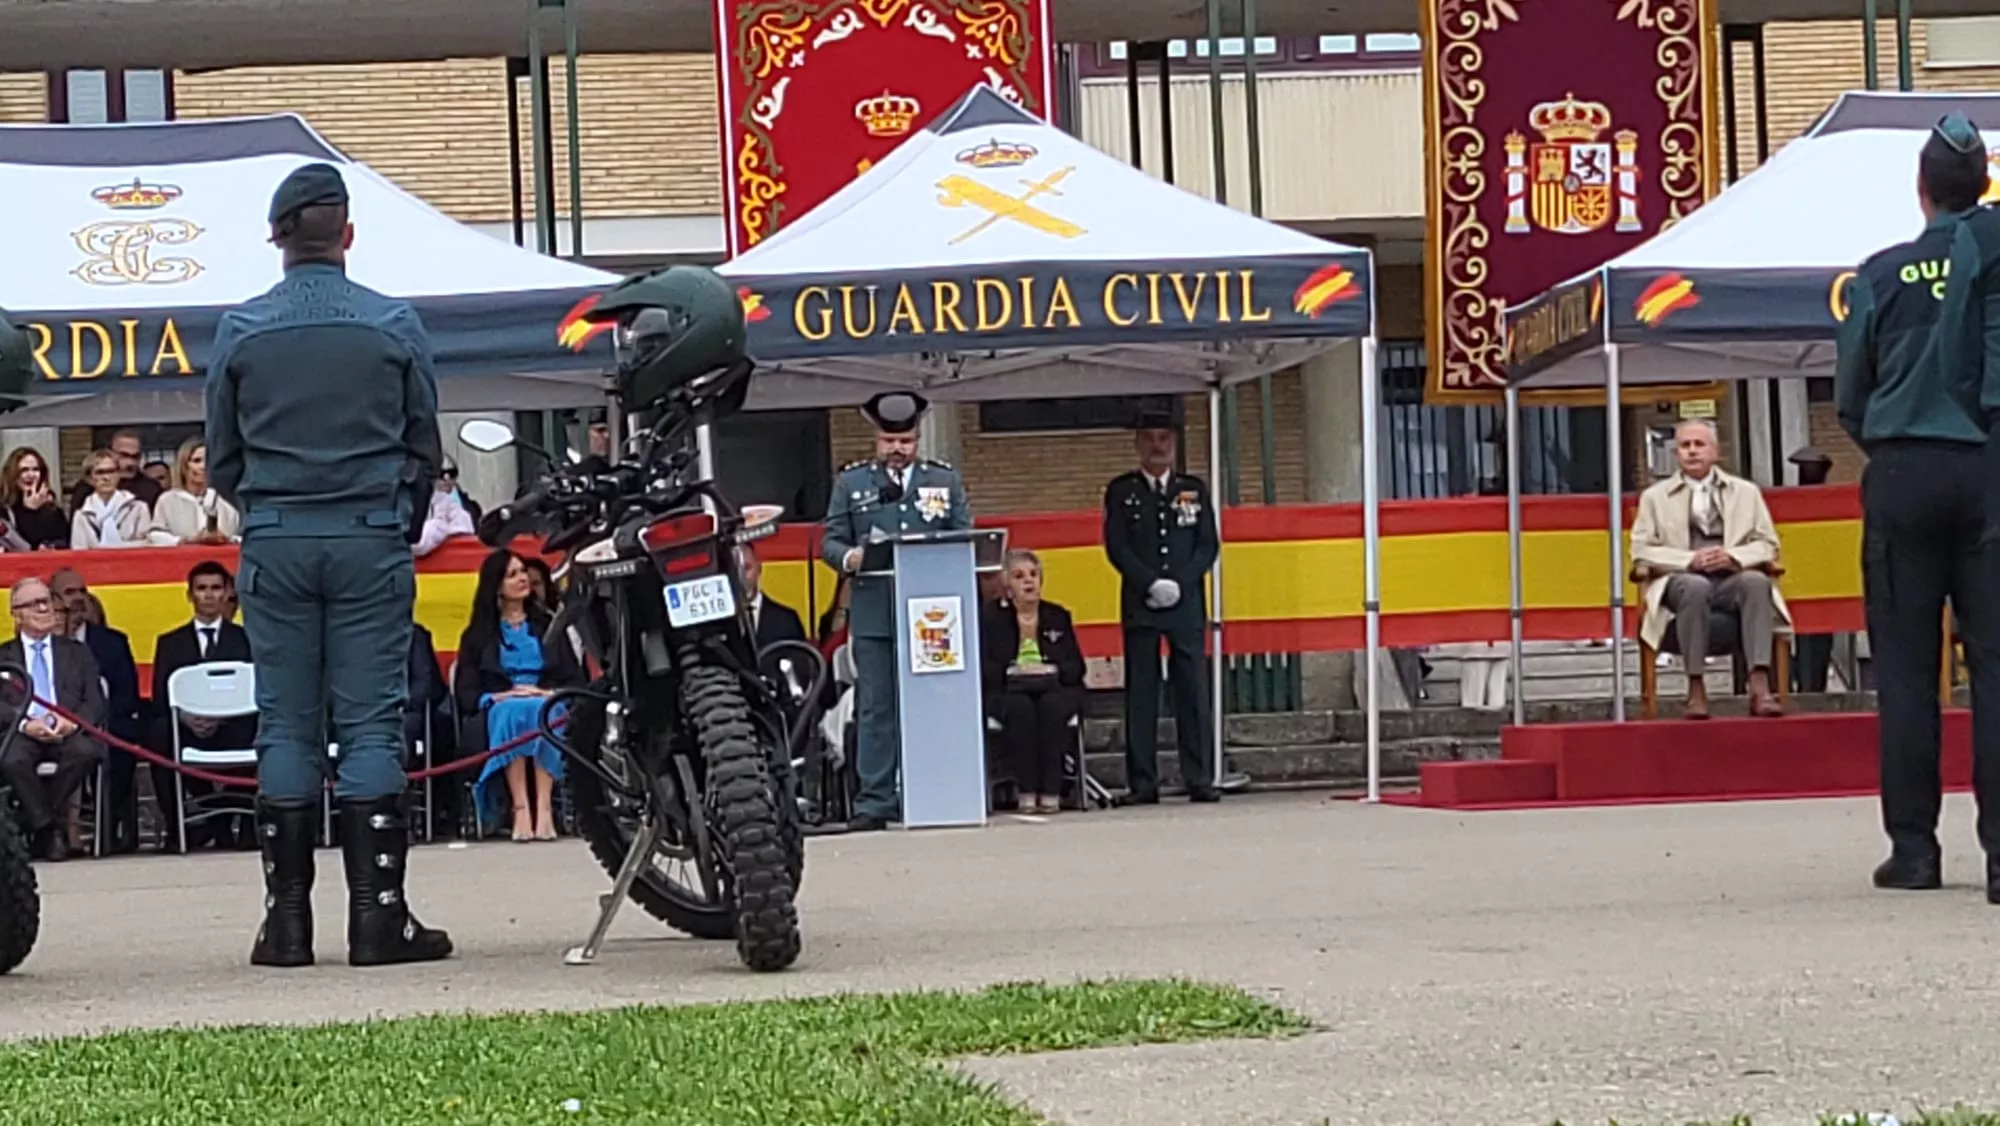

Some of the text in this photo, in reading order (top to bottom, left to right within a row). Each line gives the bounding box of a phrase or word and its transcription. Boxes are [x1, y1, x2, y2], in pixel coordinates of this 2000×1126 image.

[794, 270, 1271, 341] GUARDIA CIVIL
[28, 317, 194, 380] RDIA
